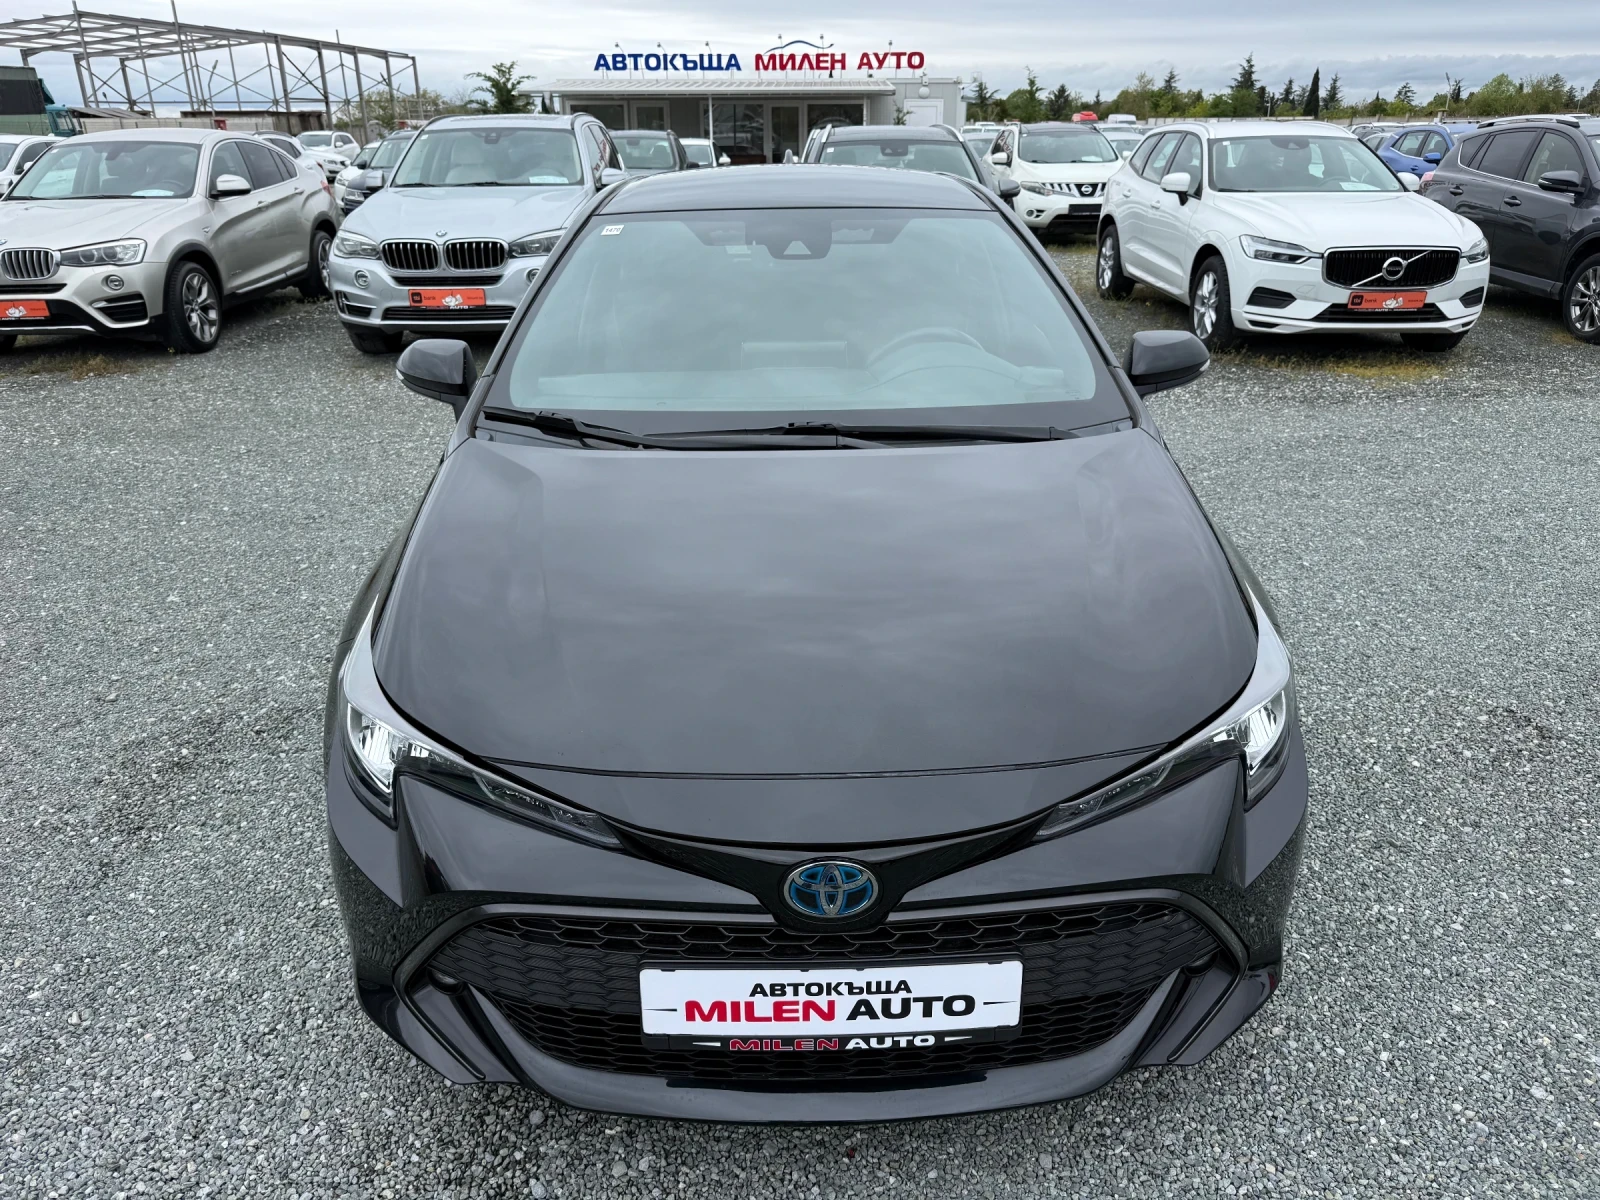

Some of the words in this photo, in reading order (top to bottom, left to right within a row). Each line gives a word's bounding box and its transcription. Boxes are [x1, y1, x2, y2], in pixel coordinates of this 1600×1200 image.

[594, 53, 742, 72] АВТОКЪЩА
[754, 53, 847, 72] МИЛЕН
[857, 51, 925, 70] АУТО
[749, 979, 913, 998] АВТОКЪЩА
[684, 998, 836, 1023] MILEN
[845, 994, 976, 1022] AUTO
[729, 1037, 839, 1052] MILEN
[844, 1033, 936, 1050] AUTO
